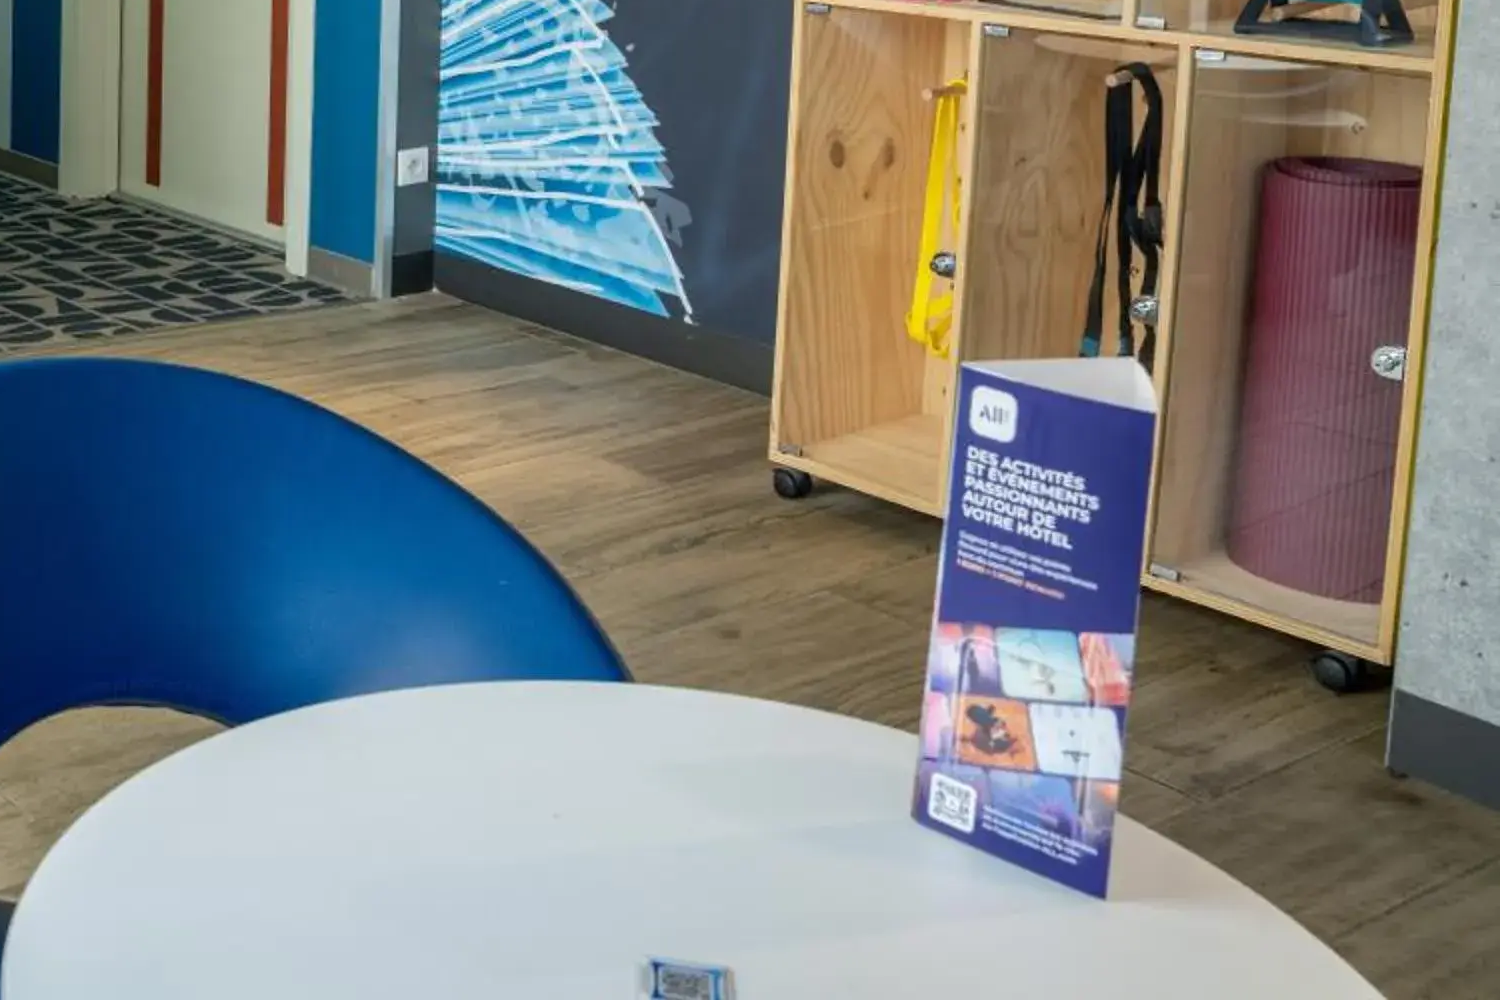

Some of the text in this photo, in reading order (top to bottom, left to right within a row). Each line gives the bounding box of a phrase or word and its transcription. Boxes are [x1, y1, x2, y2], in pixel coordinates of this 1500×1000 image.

[966, 459, 985, 477] ET
[967, 445, 999, 466] DES
[962, 489, 1057, 530] AUTOUR DE
[964, 474, 1091, 524] PASSIONNANTS
[961, 503, 1014, 532] VOTRE
